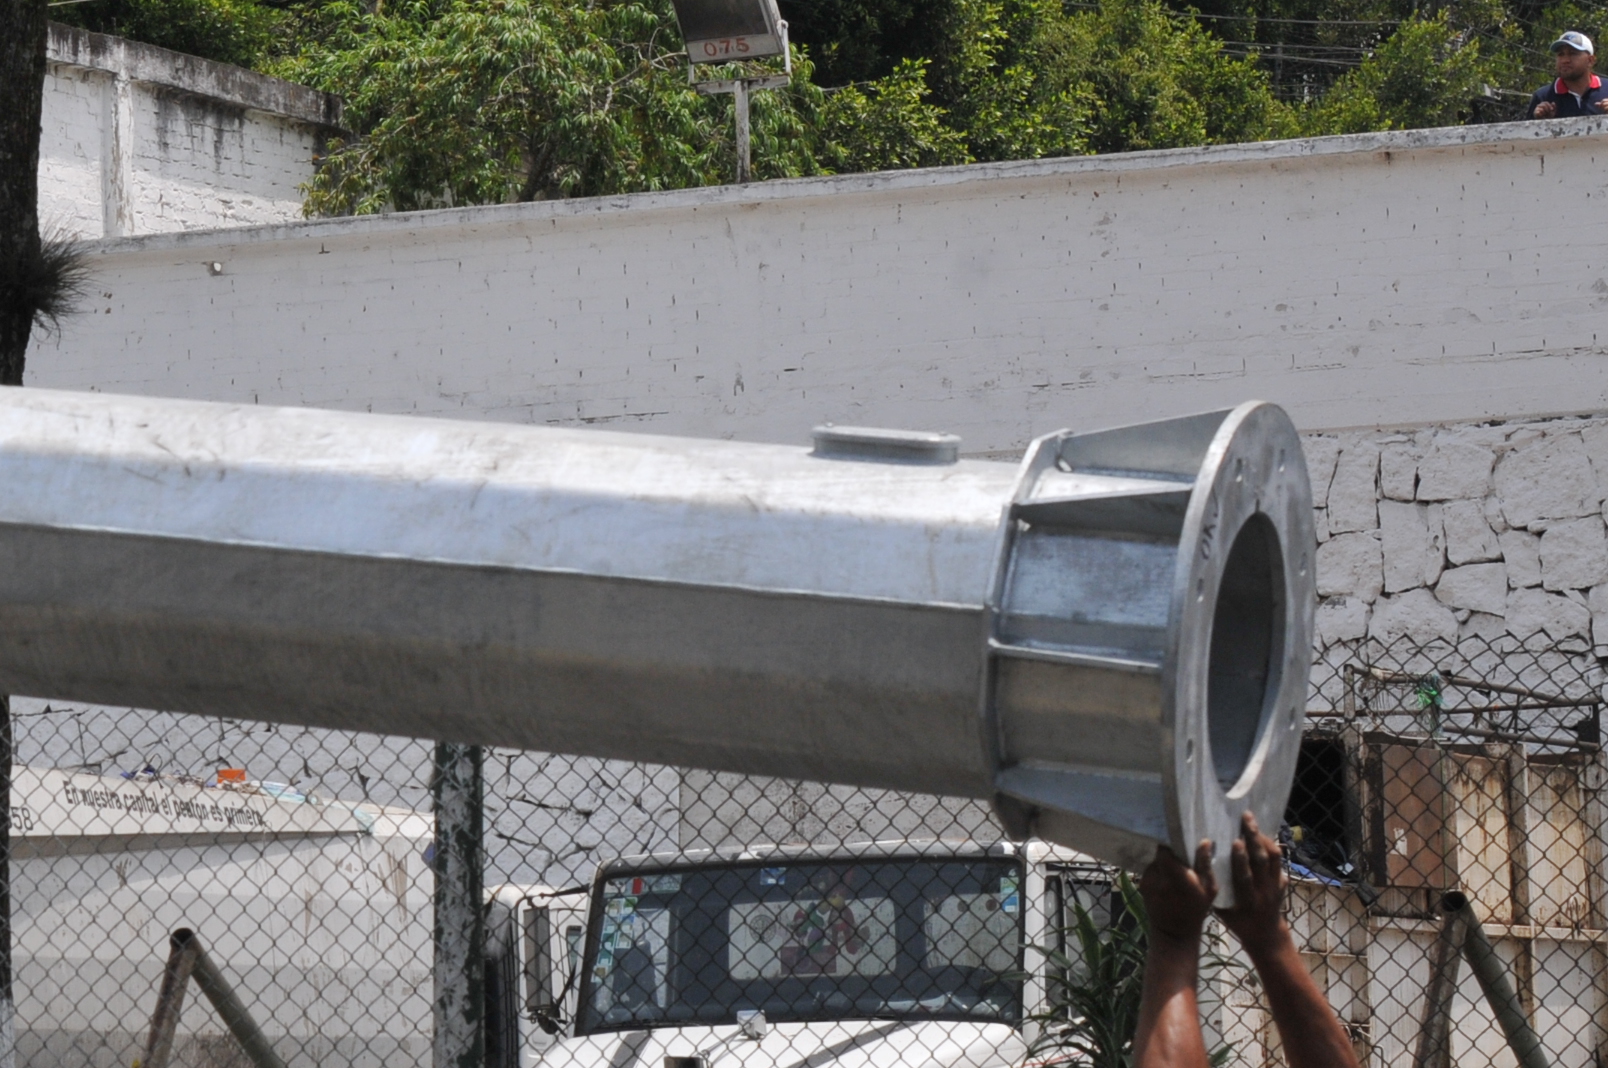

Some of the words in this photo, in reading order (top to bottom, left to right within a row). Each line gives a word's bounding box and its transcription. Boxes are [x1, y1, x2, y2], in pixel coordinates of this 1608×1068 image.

[703, 36, 750, 57] 075
[63, 780, 80, 805] En
[80, 786, 123, 811] nuestra
[123, 789, 160, 819] capital
[161, 792, 173, 817] el
[210, 803, 224, 823] es
[9, 806, 34, 831] 58
